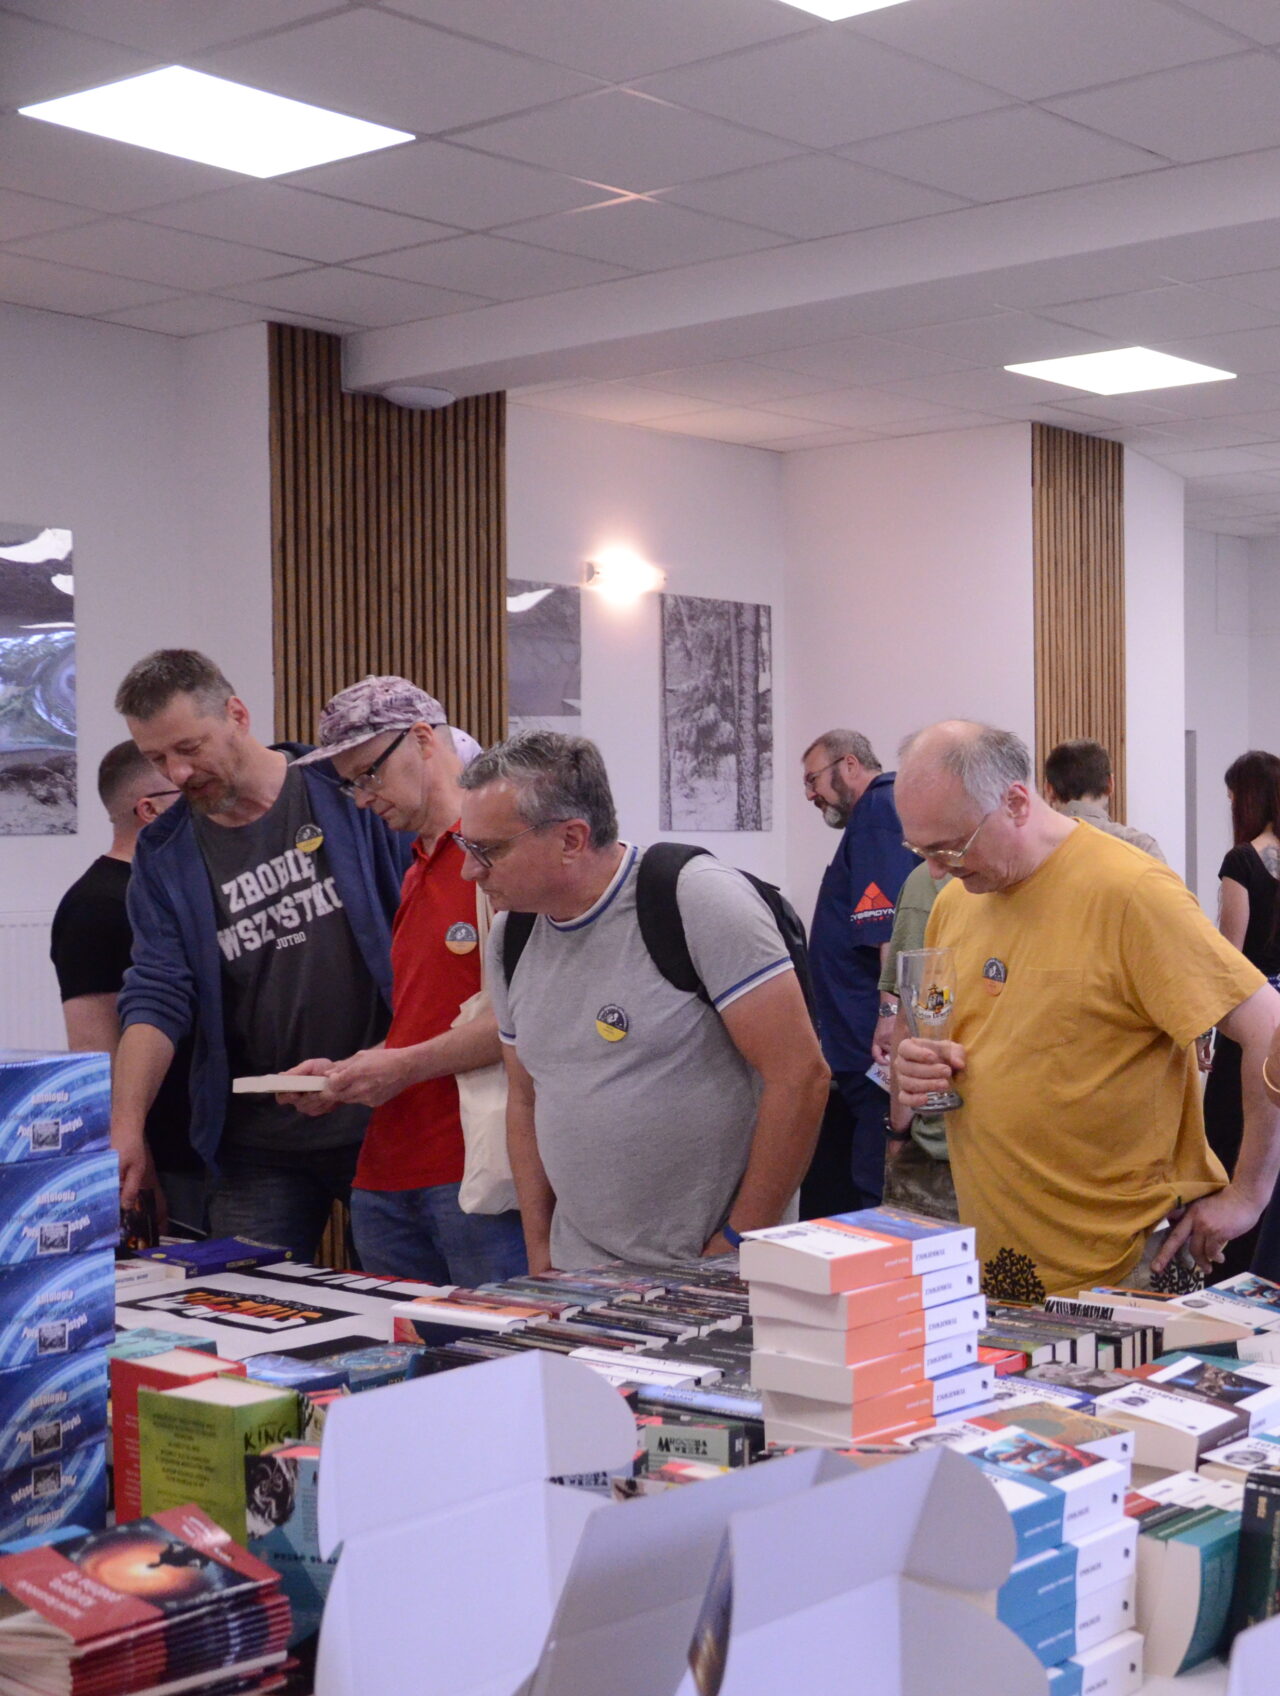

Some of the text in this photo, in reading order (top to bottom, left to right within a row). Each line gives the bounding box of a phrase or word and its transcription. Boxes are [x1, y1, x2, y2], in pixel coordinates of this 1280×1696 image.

[221, 848, 317, 914] ZROBIĘ
[850, 908, 896, 922] CYBERDYN
[275, 932, 308, 950] JUTRO
[244, 1428, 292, 1451] KING
